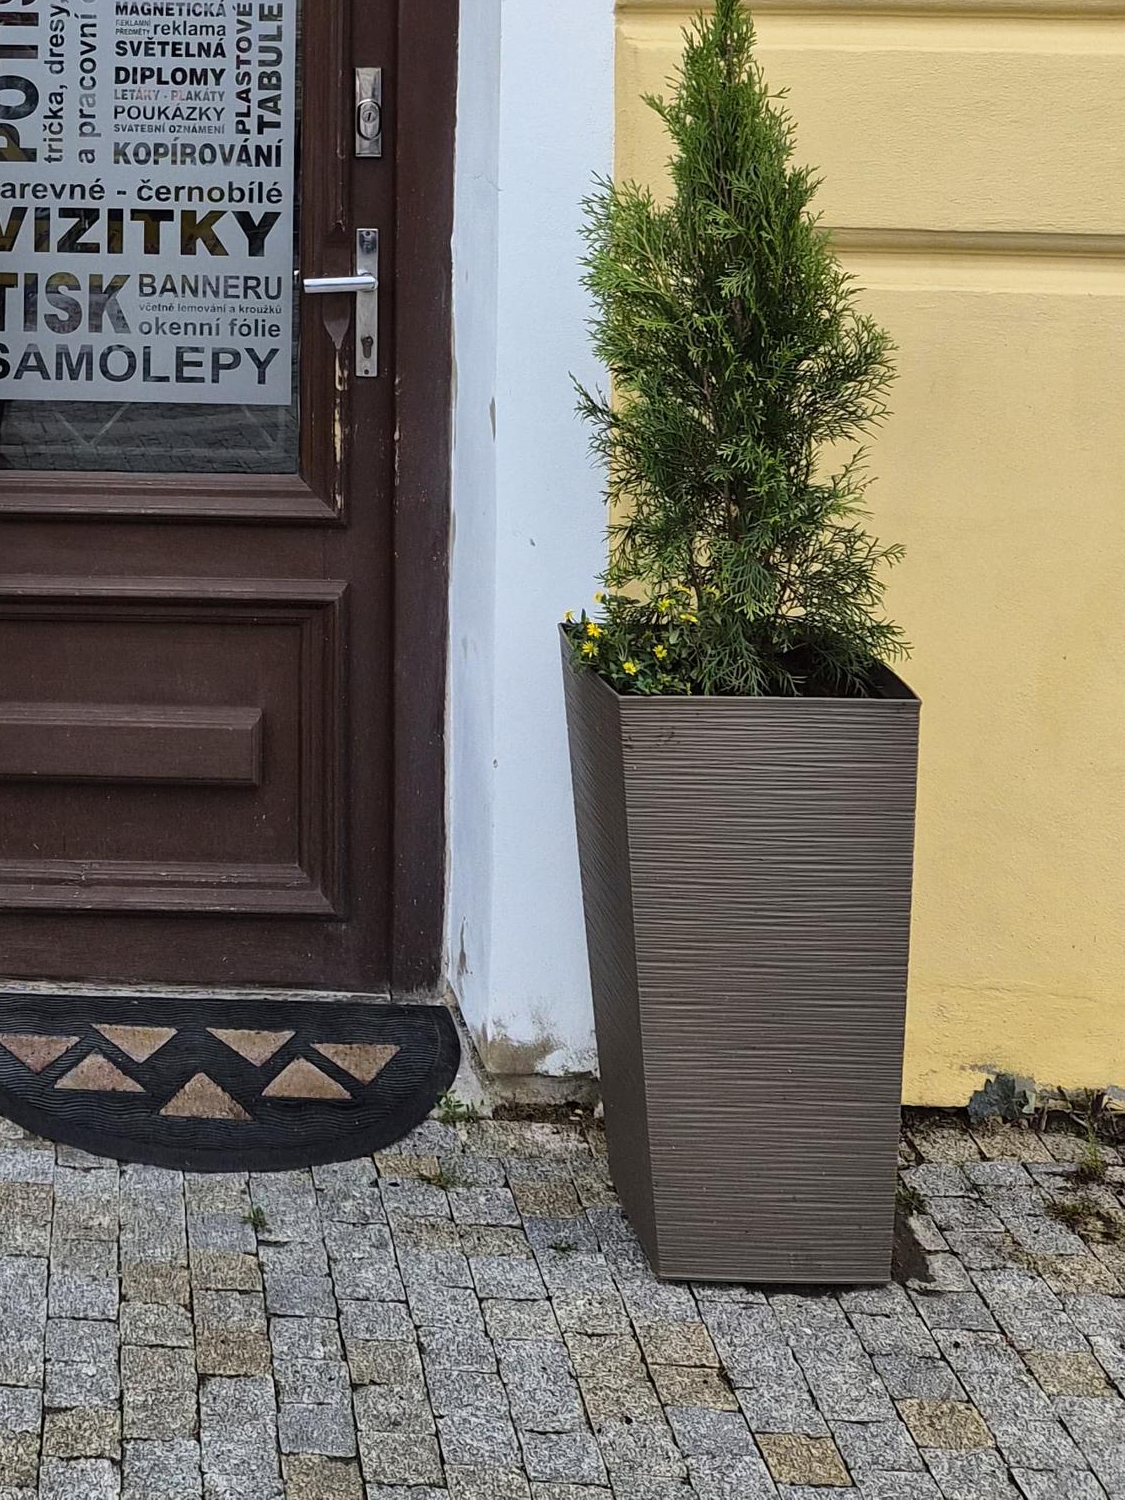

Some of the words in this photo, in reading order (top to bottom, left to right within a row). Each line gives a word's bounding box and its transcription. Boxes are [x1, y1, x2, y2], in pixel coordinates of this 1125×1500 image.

[114, 0, 227, 18] MAGNETICKÁ
[153, 20, 227, 37] reklama
[114, 36, 227, 59] SVĚTELNÁ
[74, 13, 102, 138] pracovní
[114, 66, 227, 86] DIPLOMY
[232, 2, 253, 135] PLASTOVÉ
[257, 2, 284, 135] TABULE
[114, 86, 160, 101] LETÁKY
[171, 87, 226, 102] PLAKÁTY
[113, 103, 226, 122] POUKÁZKY
[43, 84, 68, 164] trička,
[113, 122, 166, 133] SVATEBNÍ
[168, 123, 225, 135] OZNÁMENÍ
[78, 149, 96, 164] a
[113, 137, 284, 168] KOPÍROVÁNÍ
[136, 178, 283, 204] černobílé
[138, 273, 283, 300] BANNERU
[139, 302, 175, 313] včetně
[177, 302, 227, 314] lemování
[229, 306, 236, 314] a
[238, 303, 283, 315] kroužků
[138, 316, 221, 337] okenní
[229, 317, 281, 338] fólie
